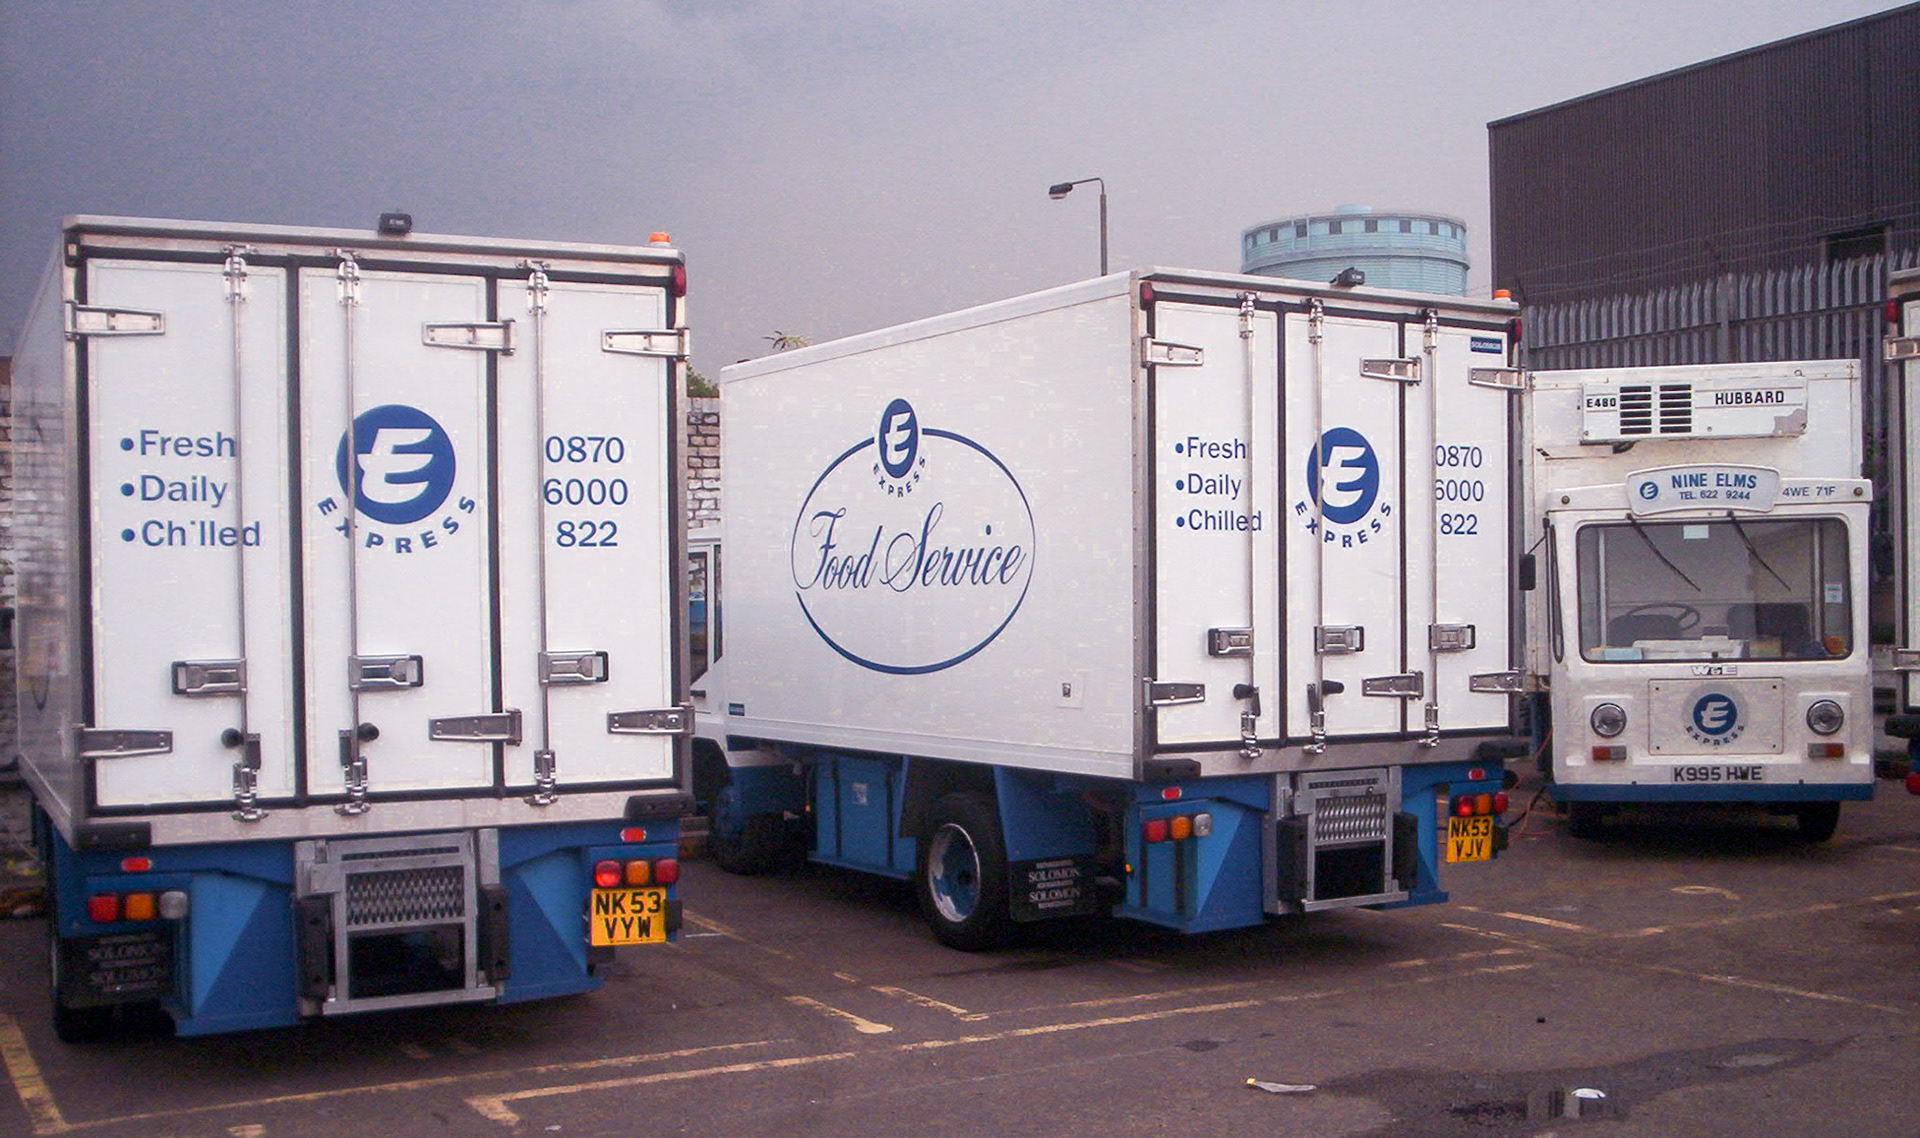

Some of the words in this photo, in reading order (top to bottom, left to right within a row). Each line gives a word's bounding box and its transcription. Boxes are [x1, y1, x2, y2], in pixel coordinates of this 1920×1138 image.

[1586, 397, 1617, 408] E480
[1715, 390, 1785, 405] HUBBARD
[140, 429, 237, 457] Fresh
[545, 435, 625, 463] 0870
[1187, 436, 1248, 459] Fresh
[1435, 445, 1482, 468] 0870
[873, 455, 926, 498] EXPRESS
[1188, 473, 1242, 500] Daily
[1672, 473, 1707, 488] NINE
[1716, 473, 1757, 489] ELMS
[140, 474, 228, 508] Daily
[543, 478, 629, 505] 6000
[1434, 479, 1485, 502] 6000
[1700, 490, 1718, 499] 622
[1726, 490, 1750, 500] 9244
[1782, 486, 1810, 497] 4WE
[1816, 486, 1836, 496] 71F
[317, 496, 476, 554] EXPRESS
[1188, 508, 1262, 531] Chilled
[1295, 501, 1392, 548] EXPRESS
[1440, 513, 1478, 535] 822
[556, 520, 618, 548] 822
[797, 507, 883, 590] Food
[880, 501, 1027, 593] Service
[1685, 725, 1745, 746] EXPRESS
[1674, 766, 1721, 781] K995
[1726, 766, 1763, 781] HWE
[1451, 819, 1490, 838] NK53
[1456, 838, 1484, 858] VJV
[595, 891, 662, 915] NK53
[604, 915, 651, 939] VYW
